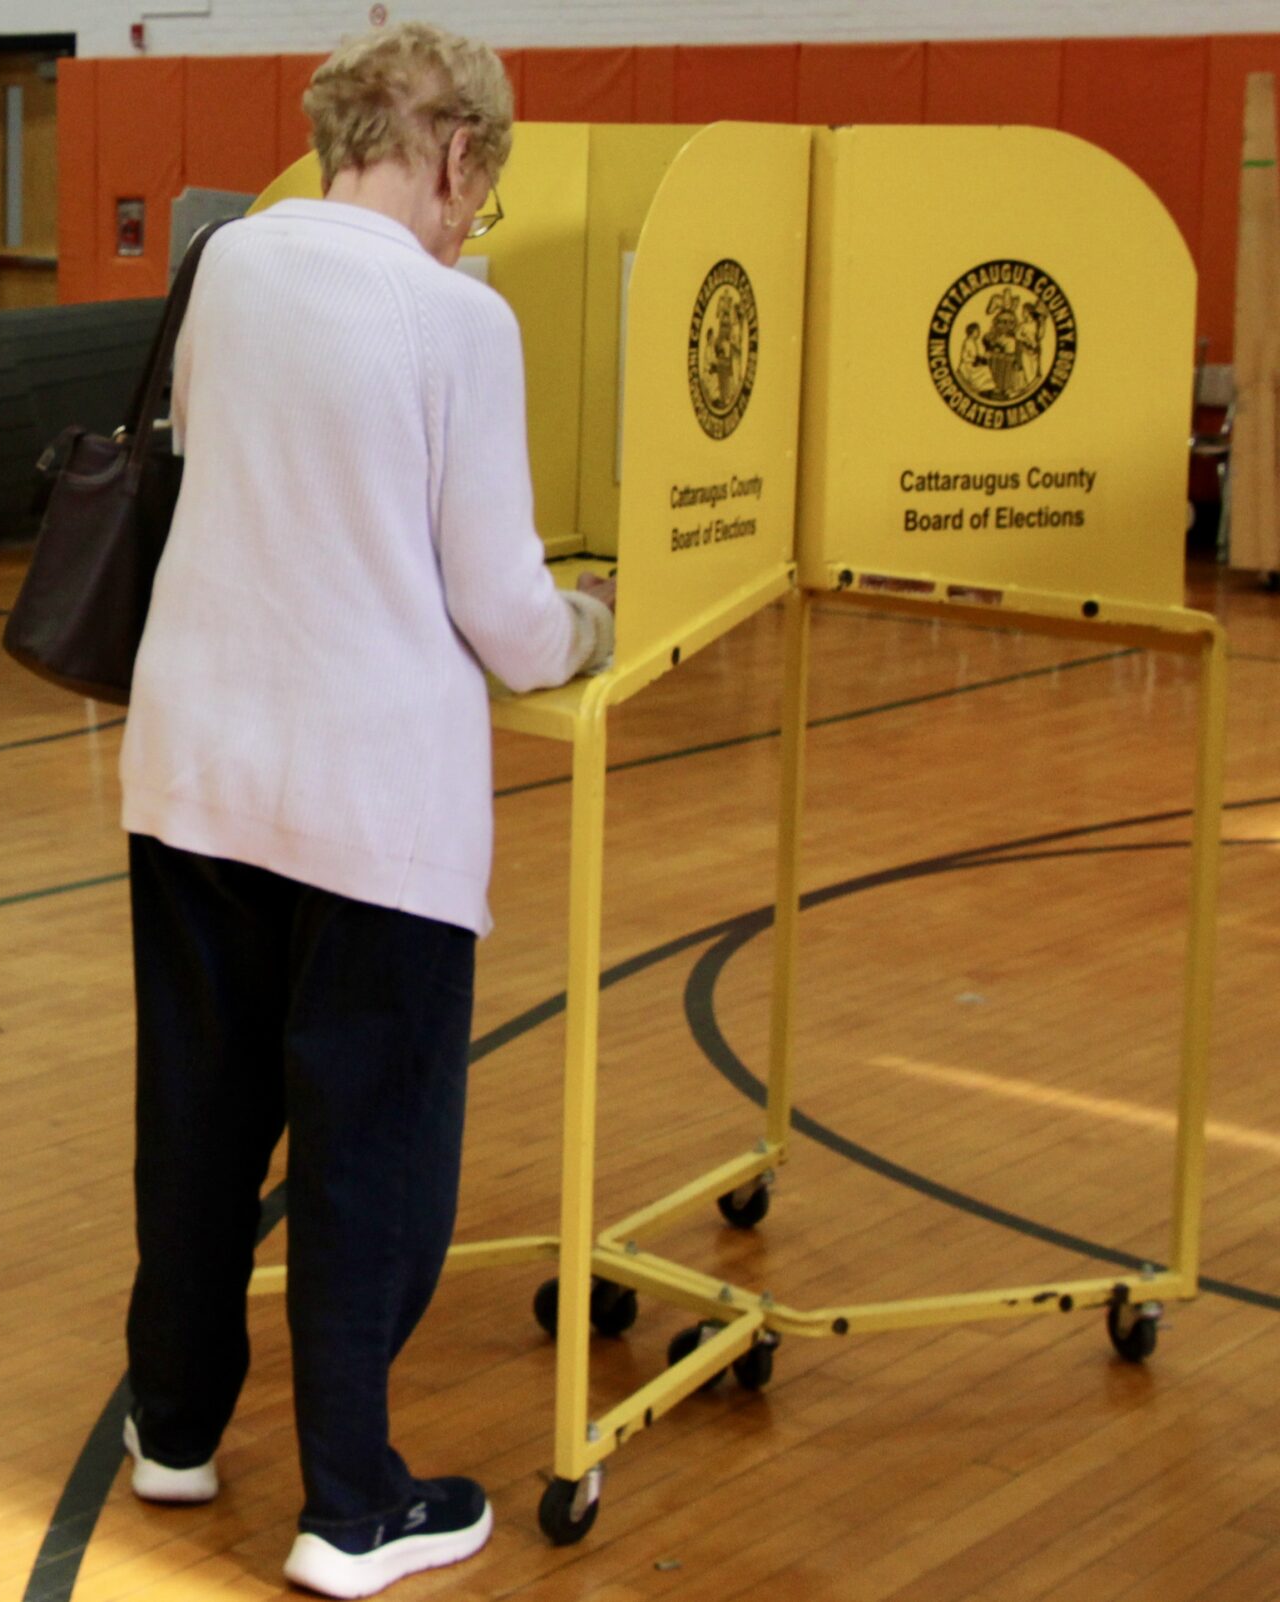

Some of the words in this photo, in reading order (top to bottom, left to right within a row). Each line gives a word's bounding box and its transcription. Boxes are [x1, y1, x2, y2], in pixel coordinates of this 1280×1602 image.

[932, 263, 1035, 335] CATTARAUGUS
[929, 338, 1005, 429] INCORPORATED
[1006, 400, 1040, 427] MAR
[1049, 350, 1074, 388] 1808
[671, 484, 728, 509] Cattaraugus
[730, 475, 763, 500] County
[900, 470, 1020, 496] Cattaraugus
[1027, 466, 1097, 493] County
[671, 526, 700, 552] Board
[703, 521, 713, 545] of
[714, 517, 757, 543] Elections
[904, 509, 964, 532] Board
[970, 507, 990, 530] of
[995, 505, 1085, 529] Elections
